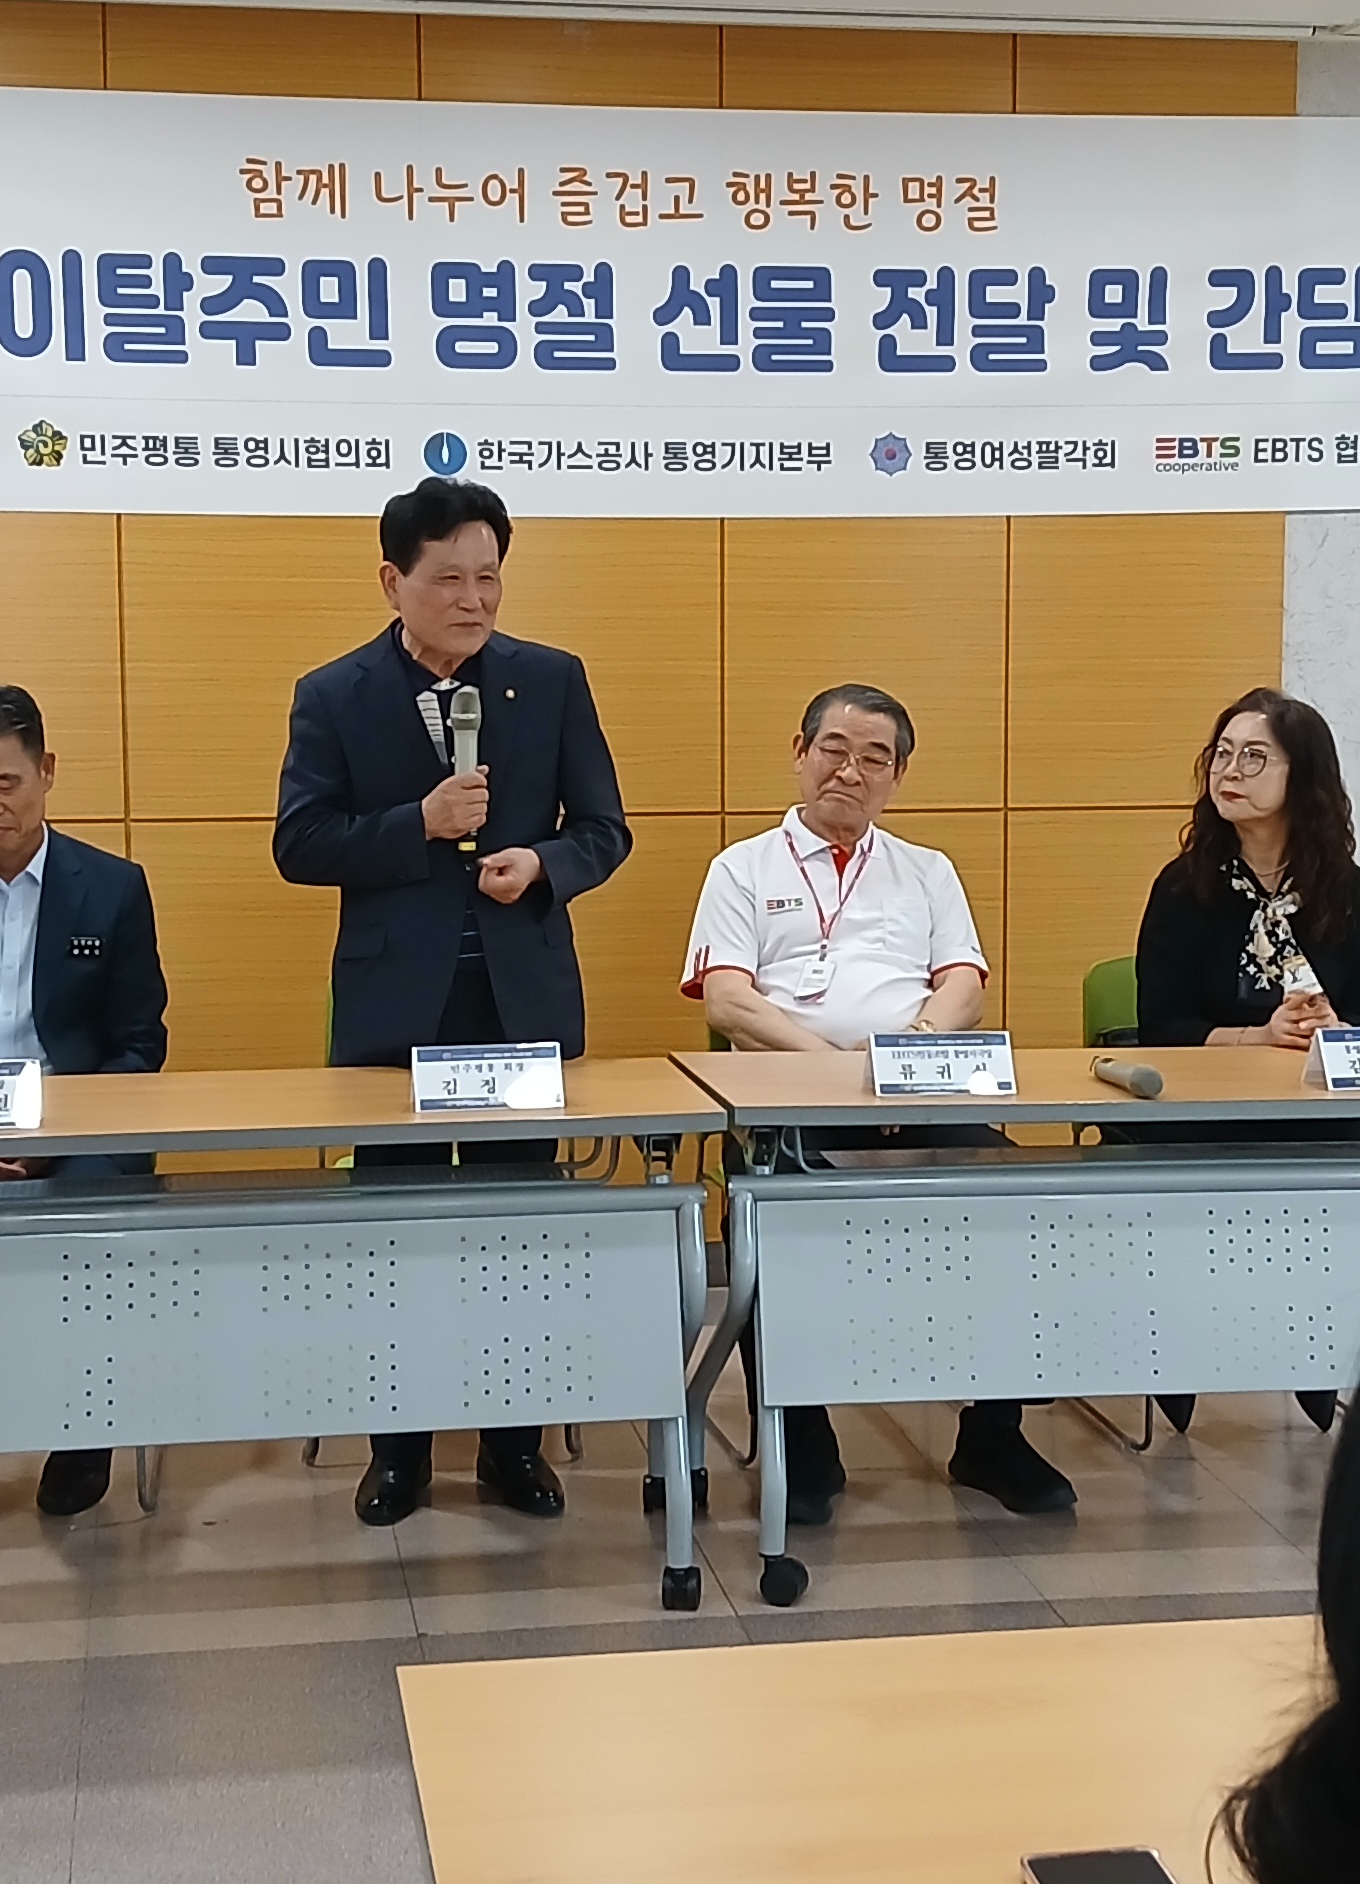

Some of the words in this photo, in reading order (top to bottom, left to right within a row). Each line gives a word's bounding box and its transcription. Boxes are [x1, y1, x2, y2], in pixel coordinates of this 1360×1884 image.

[238, 157, 347, 220] 함께
[373, 163, 525, 224] 나누어
[551, 166, 705, 228] 즐겁고
[725, 170, 880, 231] 행복한
[901, 174, 999, 233] 명절
[430, 259, 617, 372] 명절
[652, 263, 836, 373] 선물
[871, 265, 1056, 373] 전달
[1087, 265, 1170, 372] 및
[79, 433, 201, 468] 민주평통
[211, 436, 391, 470] 통영시협의회
[476, 438, 654, 472] 한국가스공사
[662, 441, 833, 473] 통영기지본부
[923, 438, 1116, 472] 통영여성팔각회
[1154, 436, 1241, 460] EBTS
[1253, 436, 1324, 464] EBTS
[1155, 459, 1240, 475] cooperative
[766, 898, 803, 909] EBTS
